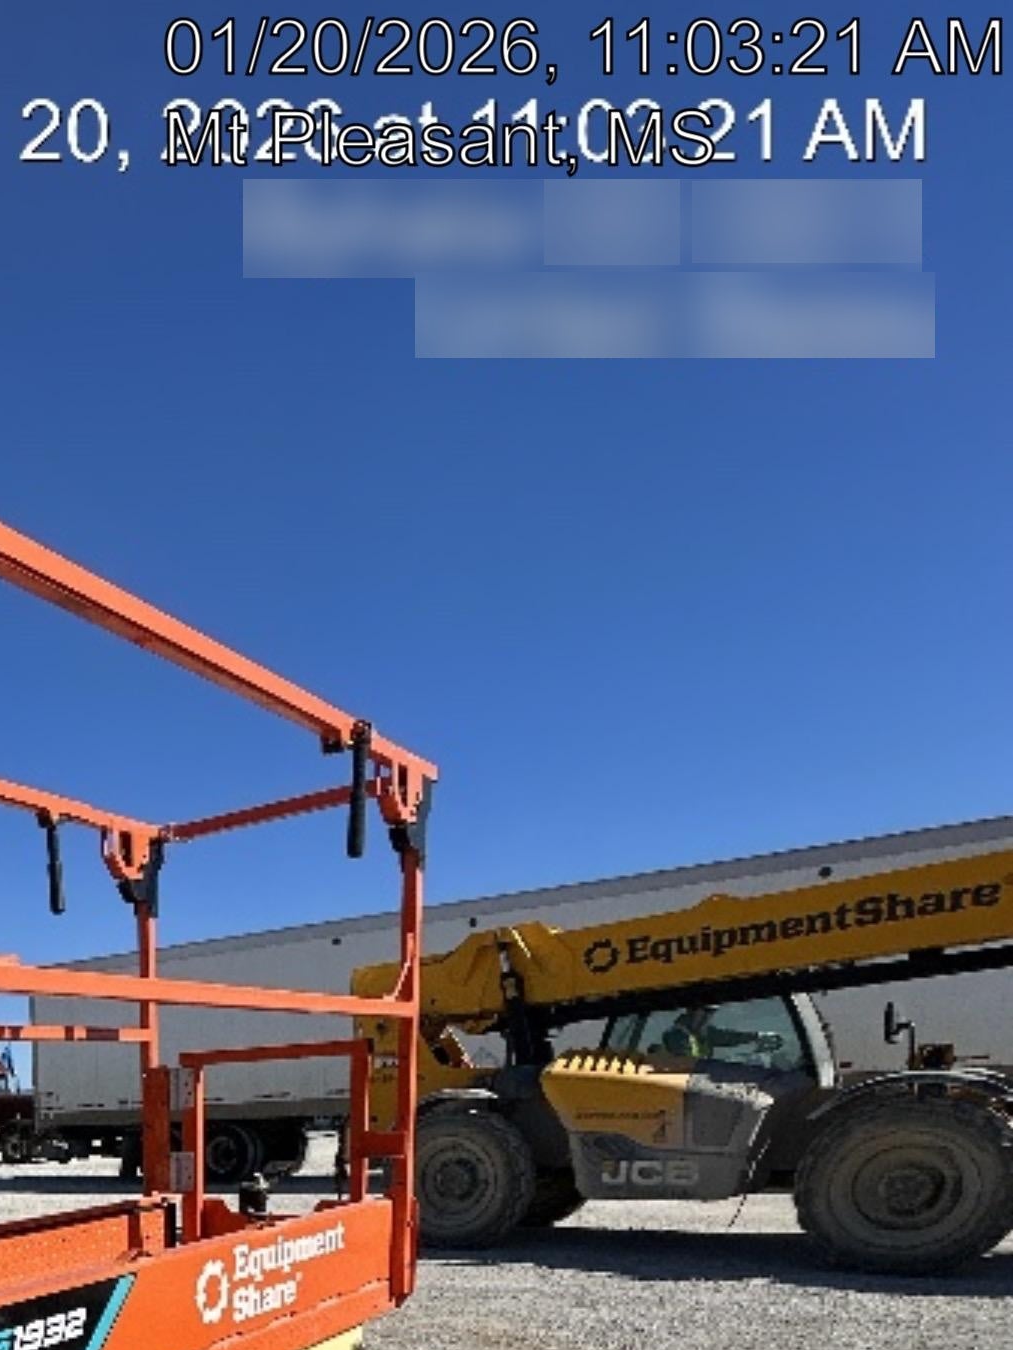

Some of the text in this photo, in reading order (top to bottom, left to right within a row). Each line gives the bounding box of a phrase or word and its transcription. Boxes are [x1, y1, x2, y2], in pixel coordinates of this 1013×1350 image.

[625, 880, 1002, 965] EquipmentShare
[601, 1160, 699, 1185] JCB
[231, 1220, 346, 1282] Equipment
[231, 1278, 299, 1323] Share
